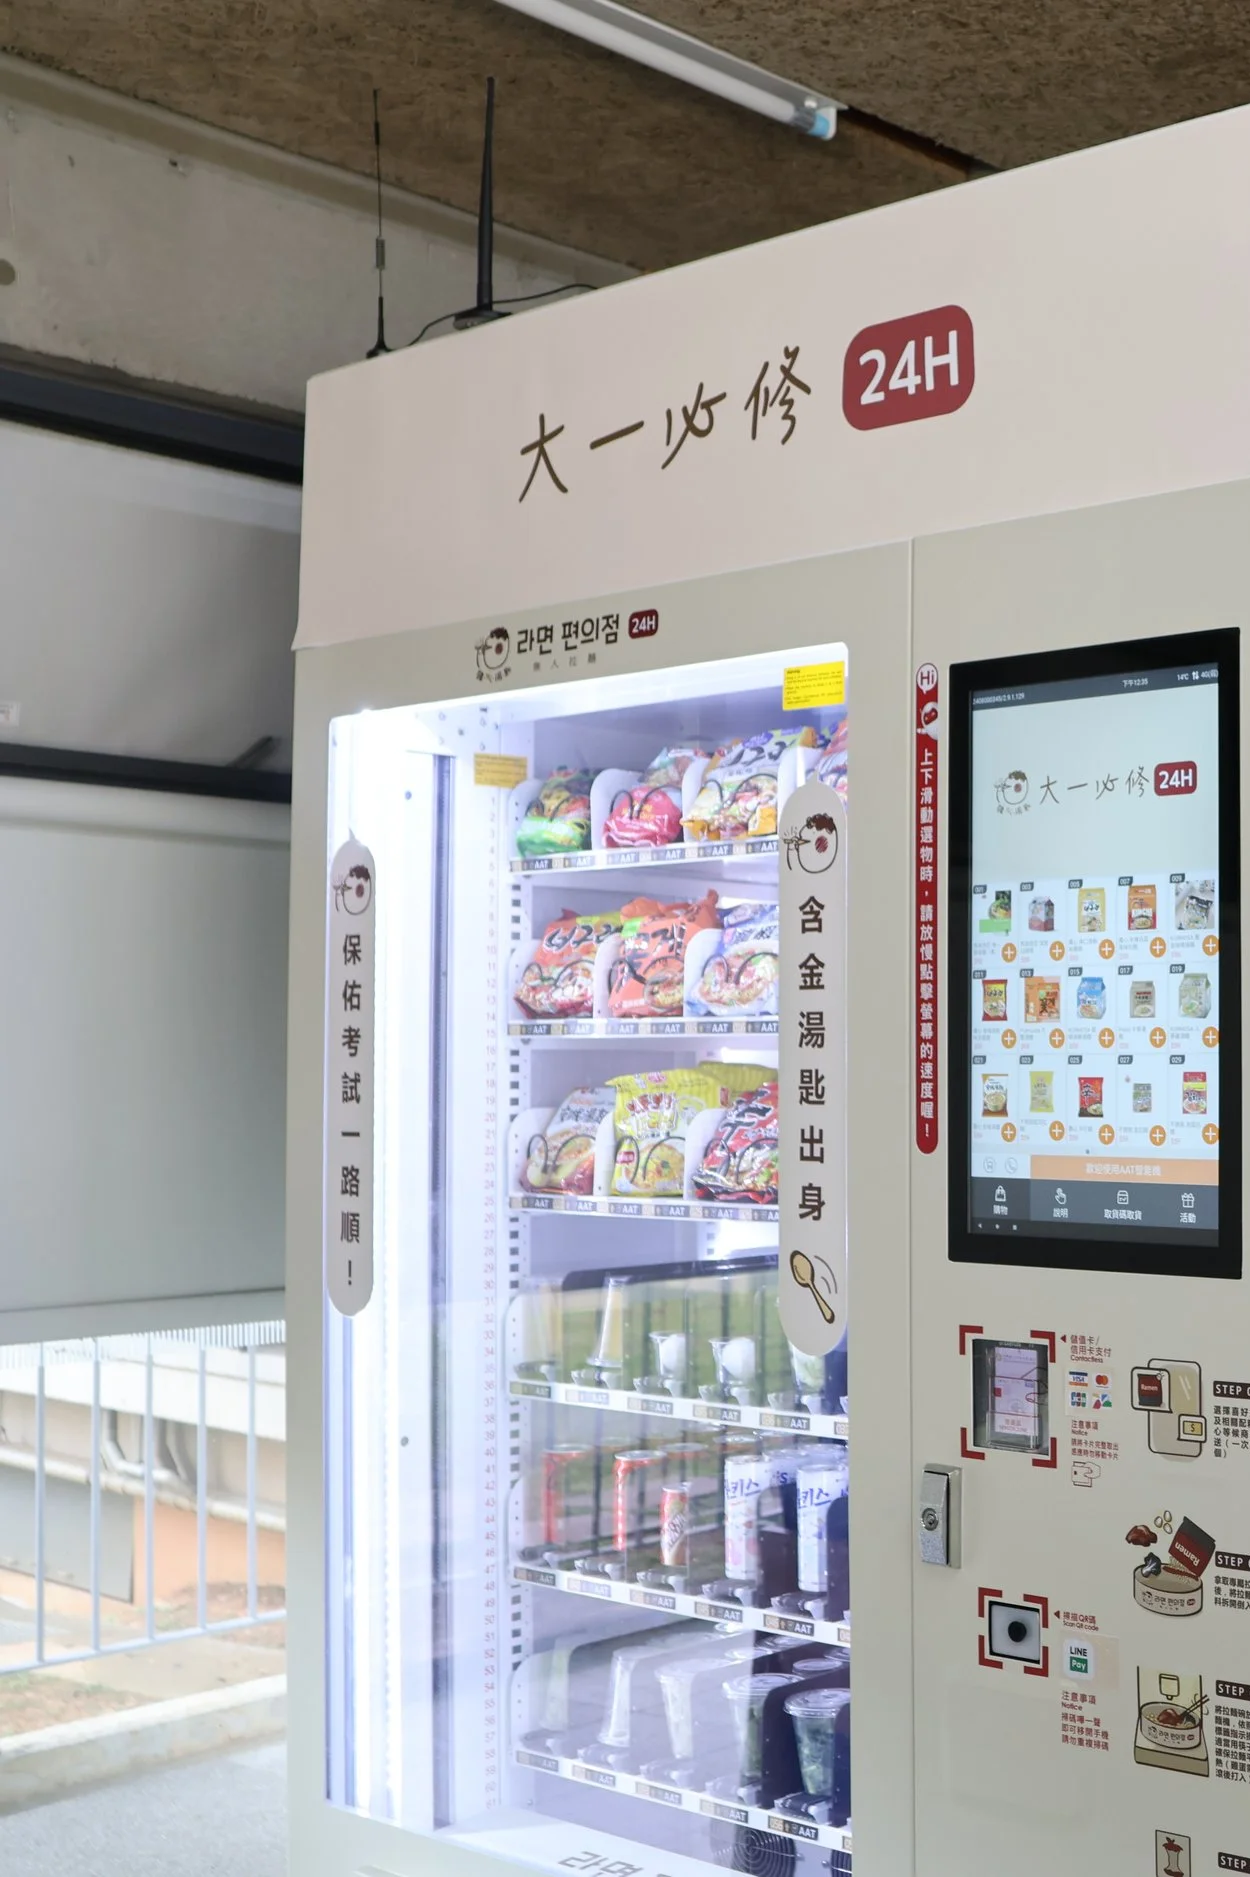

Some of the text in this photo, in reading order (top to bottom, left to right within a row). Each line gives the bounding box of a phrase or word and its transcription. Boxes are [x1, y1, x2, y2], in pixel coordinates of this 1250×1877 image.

[519, 329, 959, 503] 大一必修 24H
[517, 614, 655, 655] 라면 편의점 24H
[920, 670, 936, 687] Hi
[1040, 765, 1193, 804] 大一必修 24H
[761, 842, 778, 852] AAT
[712, 1024, 728, 1034] AAT
[761, 1024, 778, 1034] AAT
[798, 896, 826, 1222] 含金湯匙出身
[340, 933, 363, 1287] 保佑考試一路順！
[1180, 1212, 1197, 1225] 活動
[1215, 1384, 1242, 1395] STEP
[722, 1410, 739, 1421] AAT
[790, 1416, 809, 1429] AAT
[1175, 1542, 1200, 1567] Ramen
[1217, 1555, 1243, 1567] STEP
[723, 1608, 741, 1619] AAT
[794, 1622, 812, 1634] AAT
[1070, 1646, 1088, 1657] LINE
[1072, 1659, 1086, 1671] Pay
[1218, 1684, 1244, 1697] STEP
[1062, 1701, 1083, 1711] Notice
[729, 1808, 747, 1821] AAT
[798, 1826, 817, 1838] AAT
[1221, 1855, 1246, 1869] STEP
